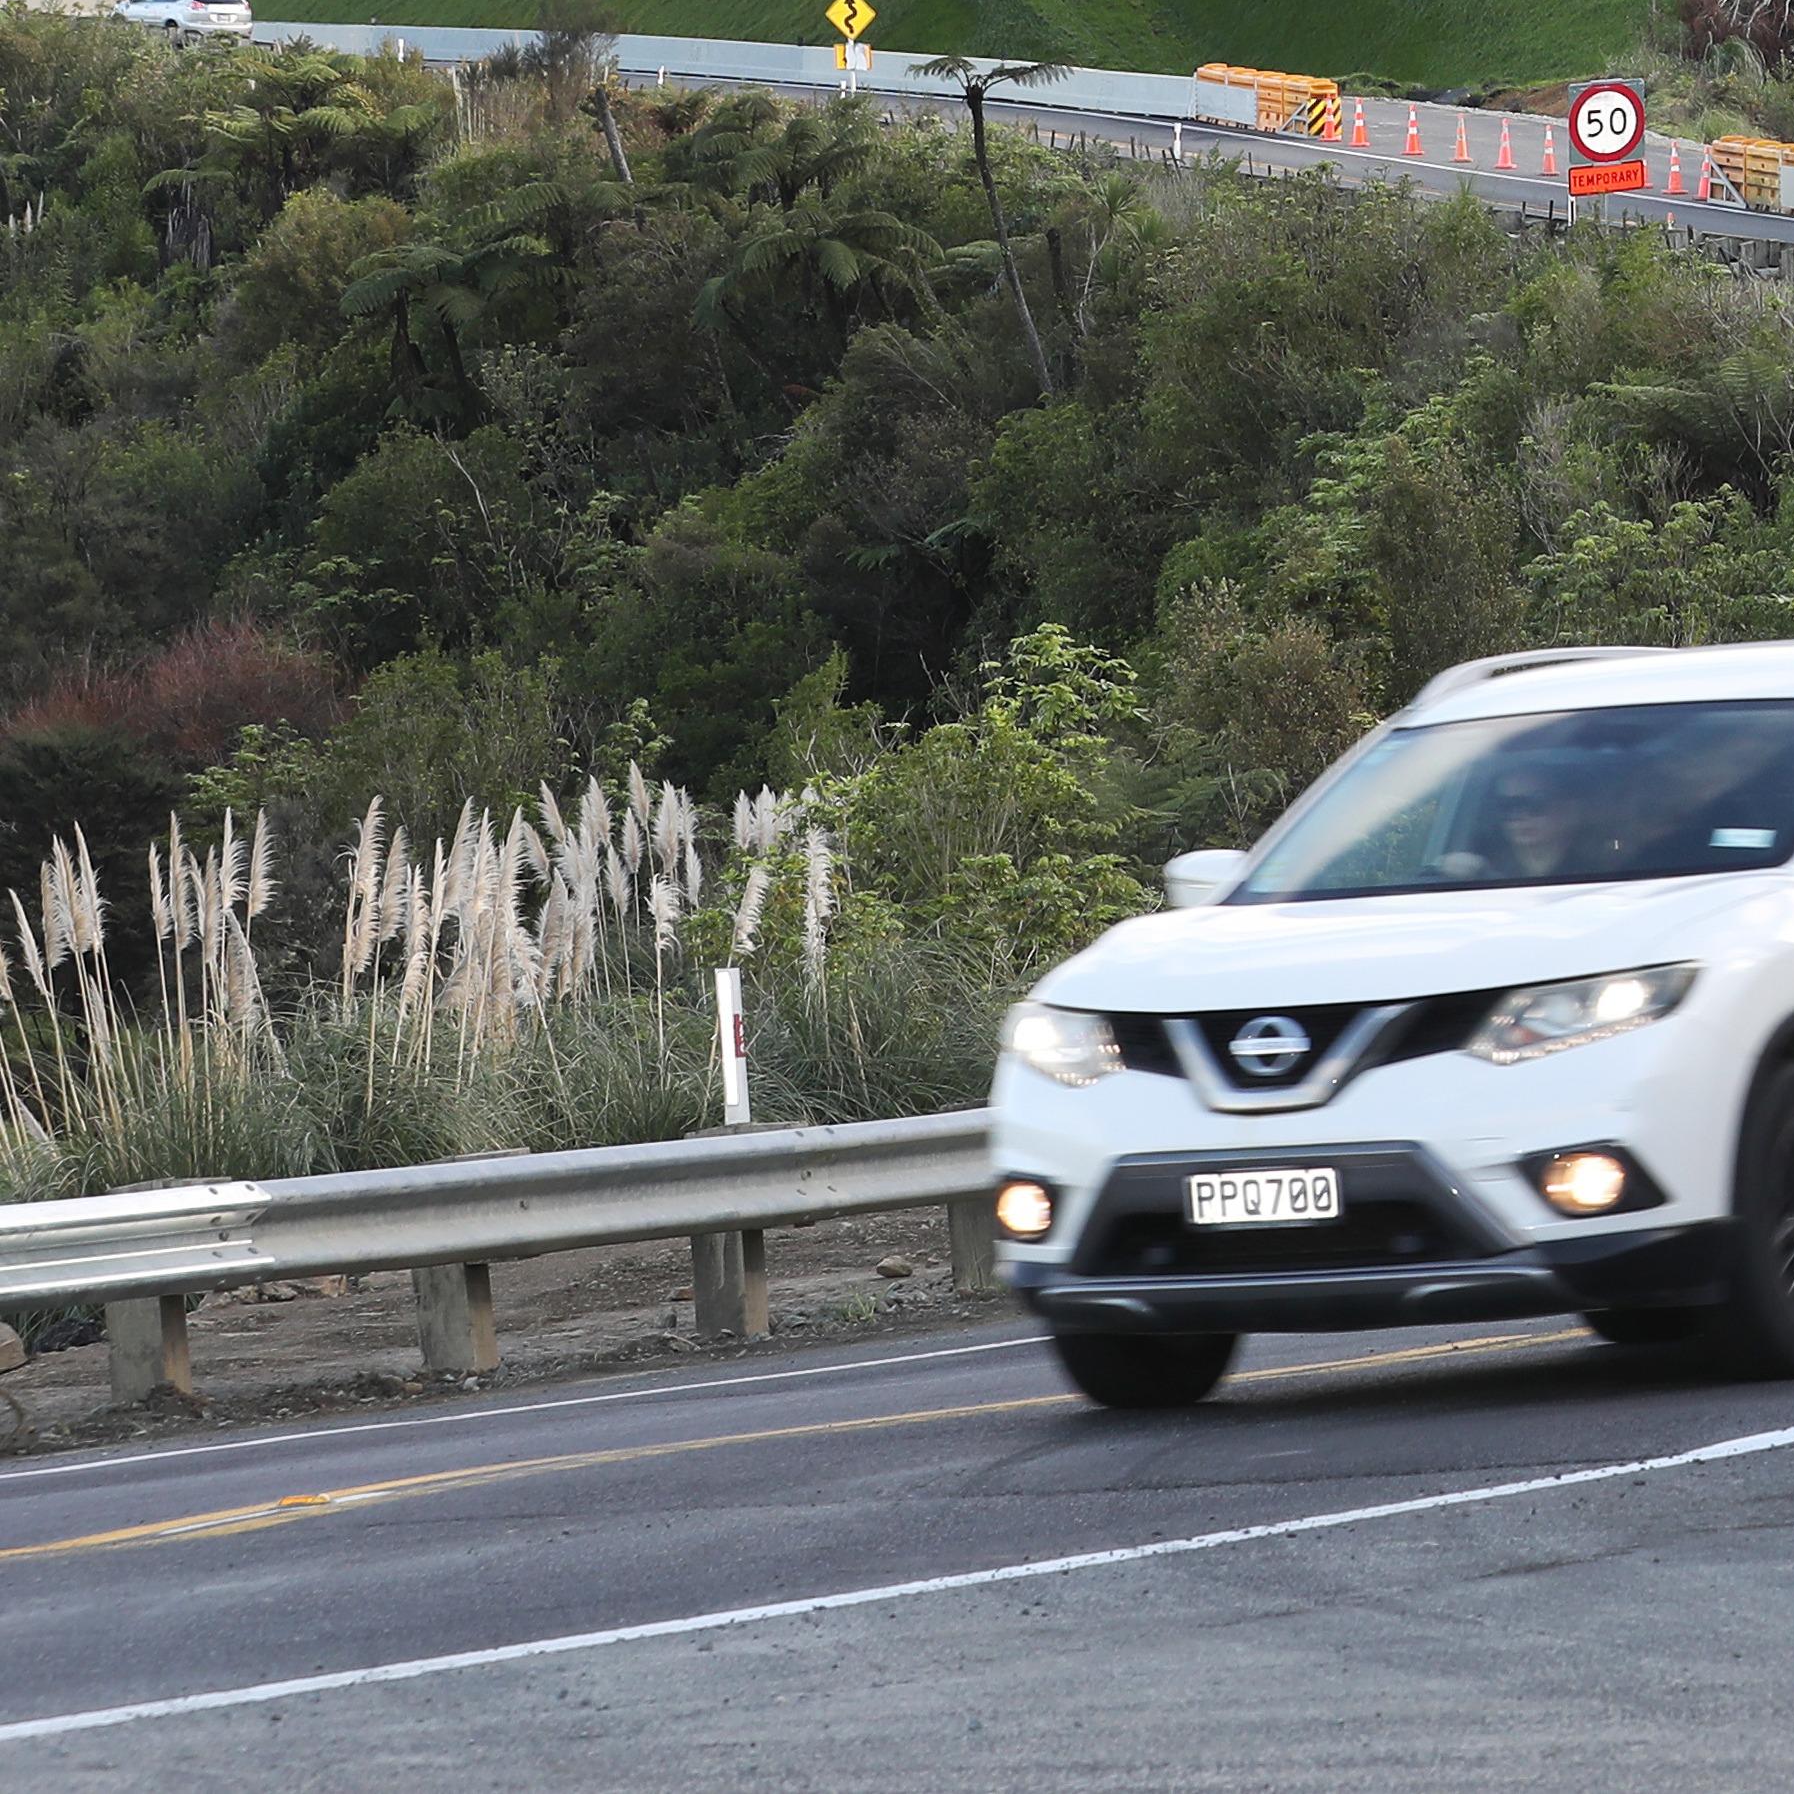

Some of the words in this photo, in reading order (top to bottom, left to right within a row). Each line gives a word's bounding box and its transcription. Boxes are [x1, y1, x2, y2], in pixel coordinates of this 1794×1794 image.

[1587, 107, 1627, 138] 50
[1572, 169, 1639, 188] TEMPORARY
[1196, 1176, 1332, 1218] PPQ700
